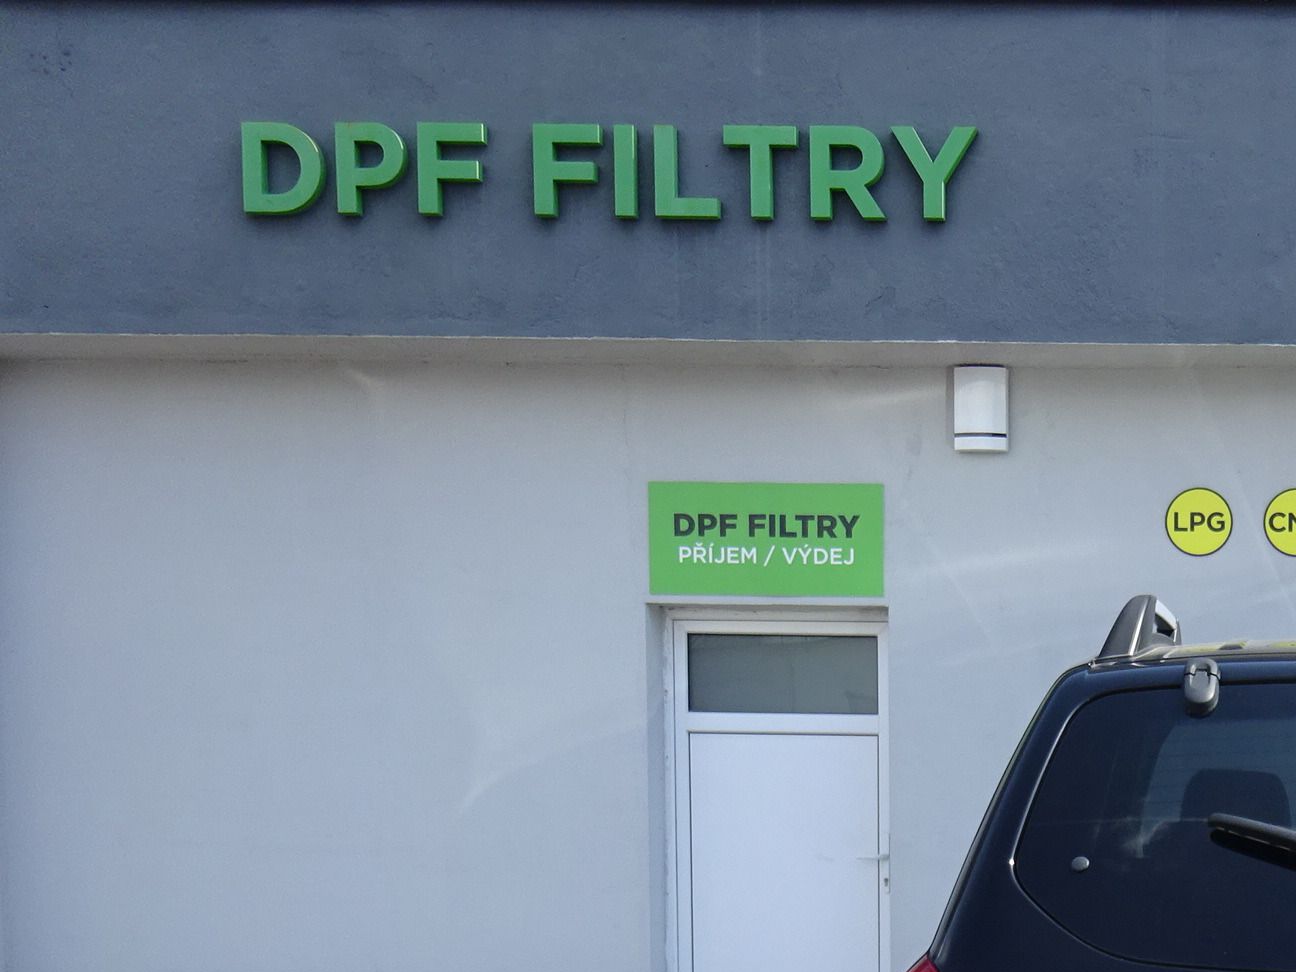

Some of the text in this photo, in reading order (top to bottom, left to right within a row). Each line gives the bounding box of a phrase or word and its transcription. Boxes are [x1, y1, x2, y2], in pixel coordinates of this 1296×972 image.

[240, 121, 979, 222] DPF FILTRY
[673, 512, 861, 539] DPF FILTRY
[1173, 511, 1226, 533] LPG
[678, 541, 855, 567] PŘÍJEM / VÝDEJ
